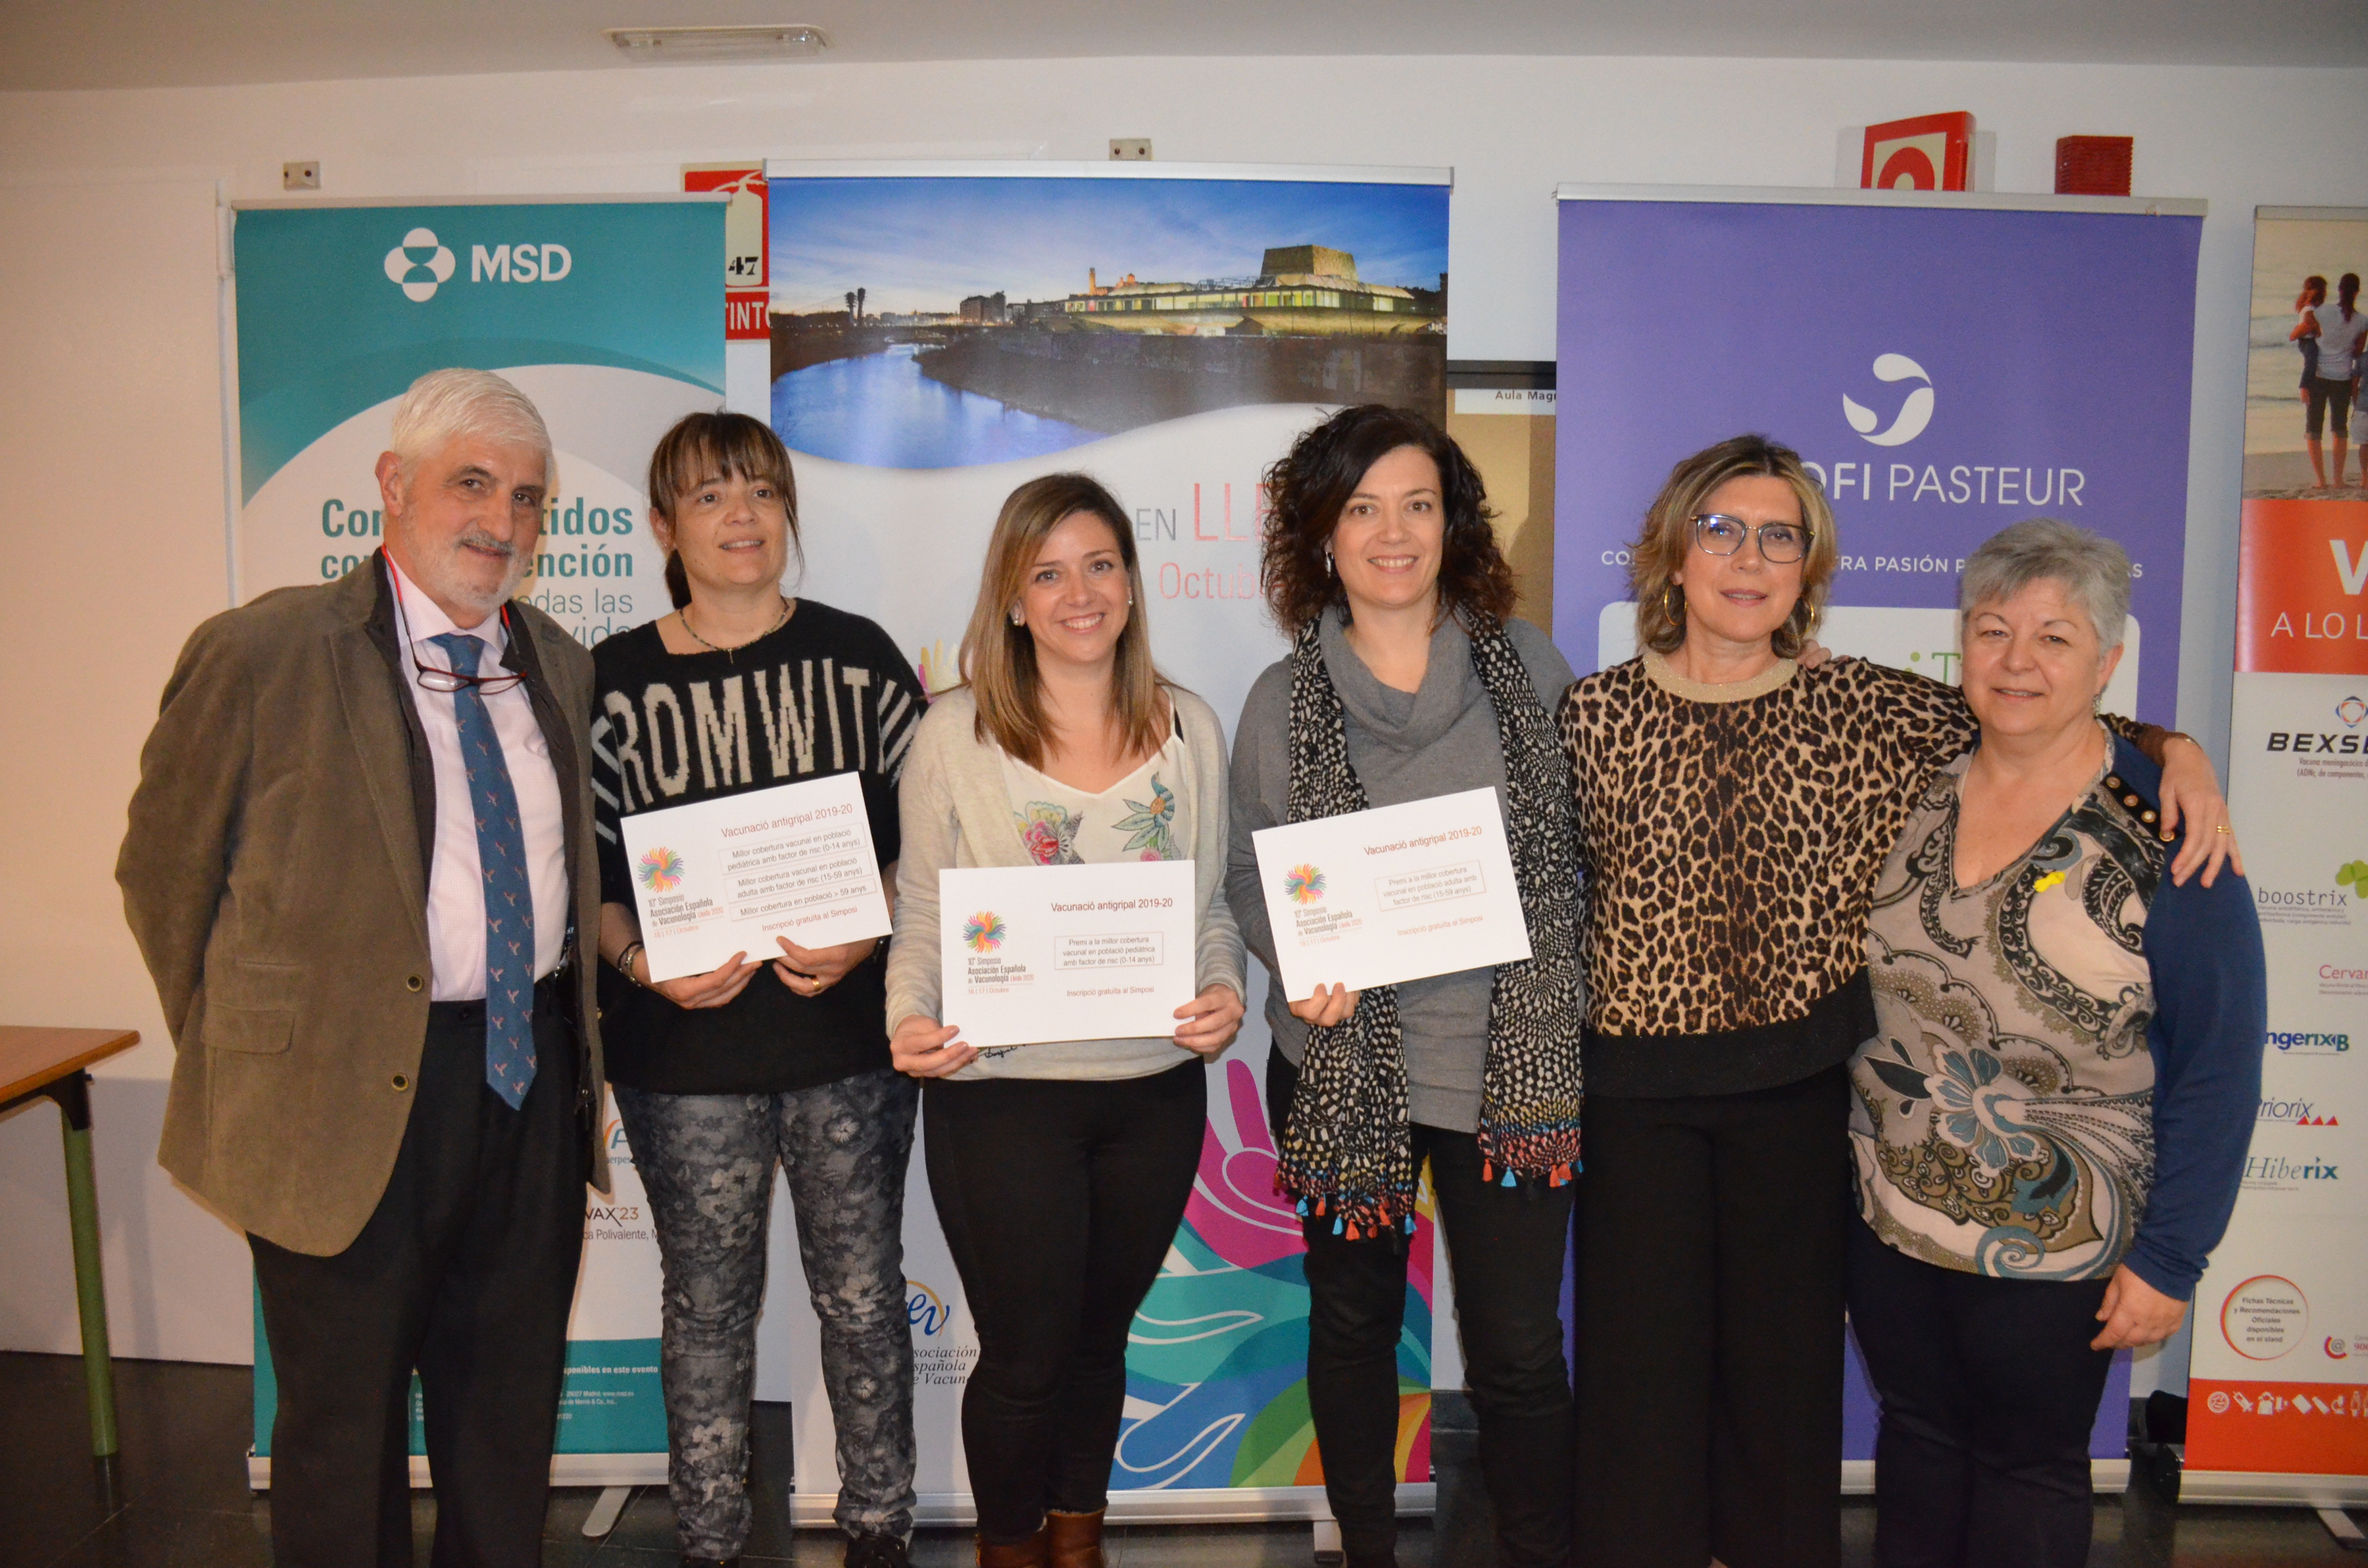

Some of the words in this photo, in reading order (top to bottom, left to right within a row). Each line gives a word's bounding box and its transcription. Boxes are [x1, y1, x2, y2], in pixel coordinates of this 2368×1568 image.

[472, 243, 572, 283] MSD
[728, 256, 759, 275] 47
[1495, 391, 1522, 400] Aula
[1889, 464, 2085, 506] PASTEUR
[1136, 509, 1176, 541] EN
[1875, 555, 1948, 572] PASIÓN
[596, 588, 633, 613] las
[2271, 612, 2294, 637] A
[2305, 612, 2346, 639] LO
[721, 820, 769, 837] Vacunació
[771, 811, 812, 828] antigripal
[814, 803, 853, 819] 2019-20
[732, 849, 750, 858] Millor
[752, 843, 784, 854] cobertura
[785, 836, 812, 847] vacunal
[823, 829, 851, 842] població
[1363, 840, 1407, 855] Vacunació
[1409, 832, 1446, 847] antigripal
[1447, 825, 1482, 840] 2019-20
[727, 858, 761, 872] pediàtrica
[762, 854, 777, 864] amb
[778, 851, 797, 860] factor
[822, 842, 840, 853] (0-14
[841, 837, 860, 848] anys)
[737, 878, 756, 886] Millor
[757, 871, 789, 883] cobertura
[791, 864, 818, 876] vacunal
[828, 856, 857, 870] població
[1388, 877, 1407, 886] Premi
[1438, 867, 1467, 877] cobertura
[737, 888, 758, 898] adulta
[759, 885, 775, 894] amb
[775, 881, 794, 890] factor
[820, 870, 842, 883] (15-59
[844, 867, 862, 877] anys)
[1383, 886, 1407, 897] vacunal
[1417, 881, 1443, 892] població
[1443, 878, 1463, 886] adulta
[1463, 874, 1477, 883] amb
[1433, 888, 1453, 899] (15-59
[1454, 885, 1471, 895] anys)
[740, 907, 758, 916] Millor
[760, 900, 793, 912] cobertura
[803, 891, 832, 904] població
[840, 887, 849, 896] 59
[850, 885, 866, 894] anys
[1051, 901, 1095, 911] Vacunació
[1097, 899, 1135, 911] antigripal
[1138, 897, 1172, 908] 2019-20
[2258, 886, 2347, 906] boostrix
[650, 903, 684, 919] Asociación
[684, 897, 713, 912] Española
[658, 909, 696, 926] Vacunología
[762, 919, 794, 931] Inscripció
[795, 913, 821, 926] gratuïta
[830, 905, 857, 917] Simposi
[1295, 915, 1326, 929] Asociación
[1327, 910, 1353, 924] Española
[1303, 920, 1338, 935] Vacunología
[1397, 925, 1427, 936] Inscripció
[1427, 921, 1451, 932] gratuïta
[1458, 914, 1483, 925] Simposi
[976, 956, 1001, 966] Simposio
[1098, 947, 1124, 956] població
[1125, 946, 1155, 954] pediàtrica
[1119, 956, 1135, 965] (0-14
[1137, 955, 1155, 965] anys)
[967, 965, 999, 975] Asociación
[1000, 963, 1026, 974] Española
[974, 973, 1008, 984] Vacunología
[1067, 988, 1096, 997] Inscripció
[1098, 987, 1121, 996] gratuïta
[1130, 986, 1154, 994] Simposi
[2258, 1097, 2314, 1118] riorix
[2242, 1156, 2339, 1180] Hiberix
[596, 1229, 649, 1241] Polivalente,
